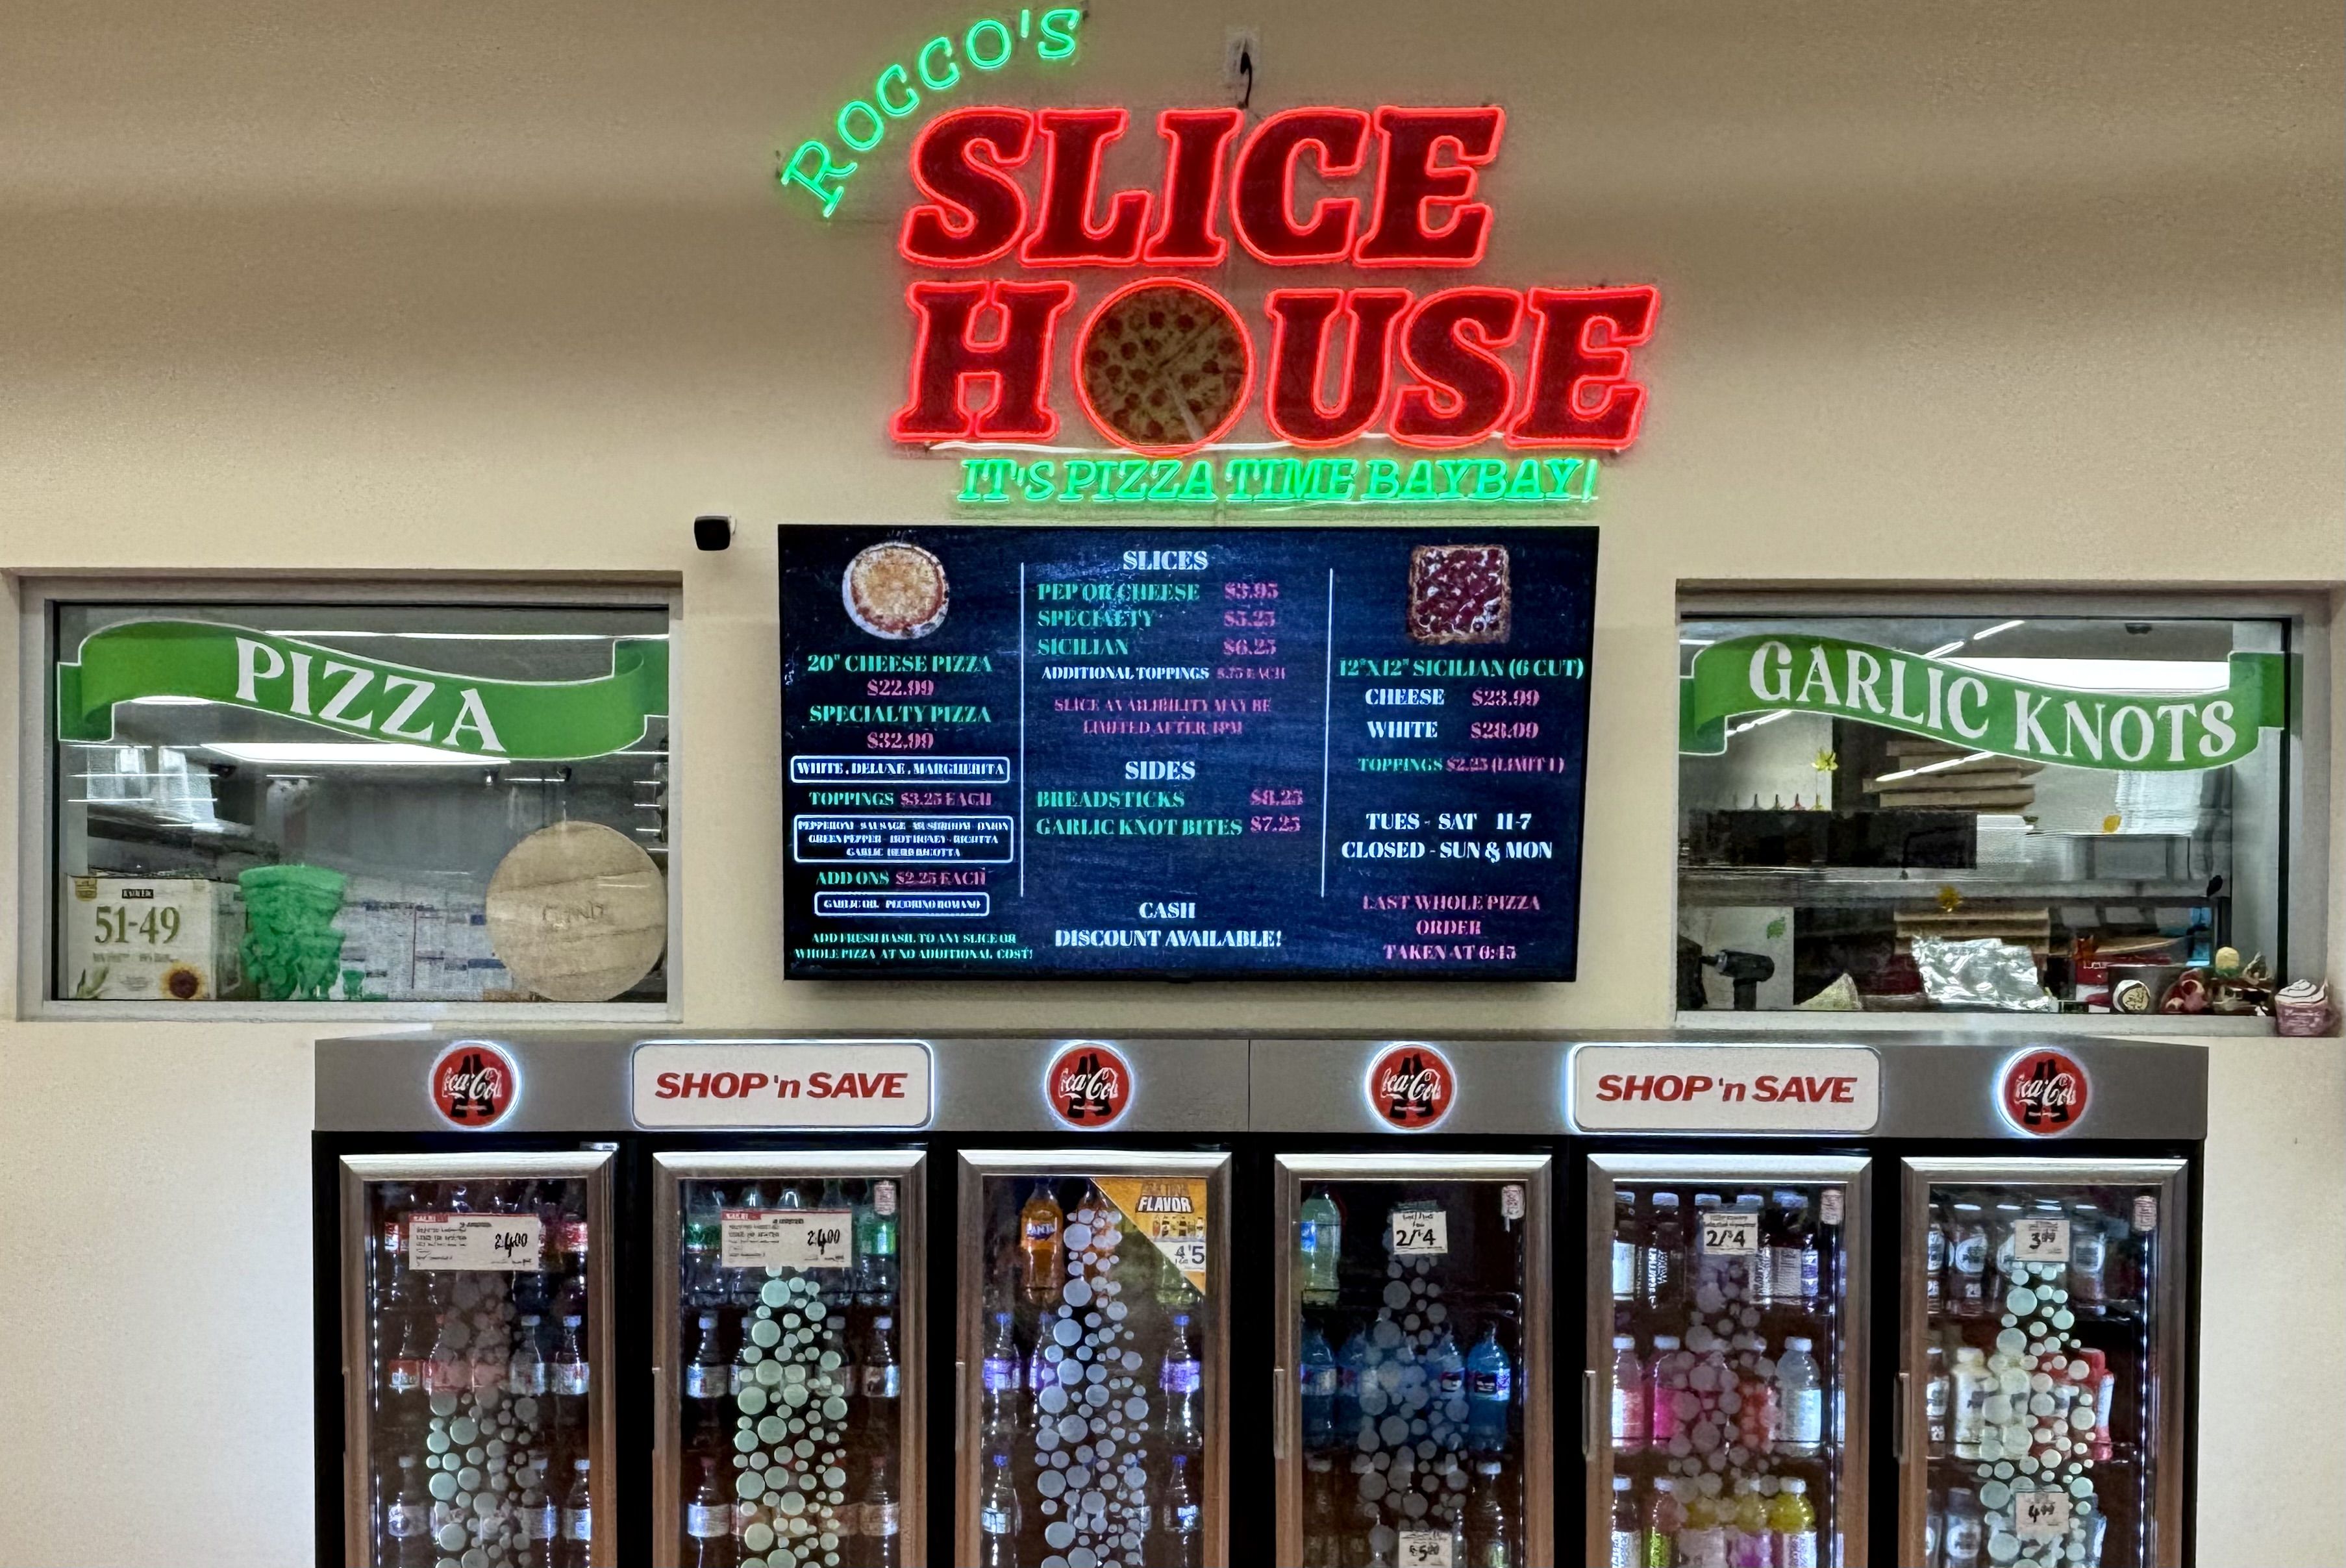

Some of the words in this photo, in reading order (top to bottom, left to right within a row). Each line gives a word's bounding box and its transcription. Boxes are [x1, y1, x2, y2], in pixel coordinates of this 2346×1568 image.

[780, 7, 1082, 218] ROCCO'S
[899, 105, 1506, 268] SLICE
[890, 277, 1661, 458] HOUSE
[957, 458, 1056, 503] IT'S
[1058, 458, 1216, 503] PIZZA
[1225, 458, 1356, 503] TIME
[1366, 458, 1599, 503] BAYBAY!
[1123, 551, 1209, 571] SLICES
[1038, 583, 1079, 601] PEP
[1082, 583, 1116, 601] OR
[1117, 583, 1200, 601] CHEESE
[1038, 610, 1154, 627] SPECIALTY
[1038, 638, 1129, 655] SICILIAN
[807, 654, 840, 672] 20"
[845, 654, 927, 672] CHEESE
[932, 655, 993, 673] PIZZA
[1413, 660, 1504, 677] SICILIAN
[1509, 658, 1529, 679] (6
[1534, 658, 1584, 679] CUT)
[1042, 667, 1134, 679] ADDITIONAL
[1137, 667, 1210, 679] TOPPINGS
[1246, 667, 1286, 680] EACH
[234, 637, 507, 753] PIZZA
[867, 679, 934, 696] $22.99
[1054, 699, 1099, 712] SLICE
[1214, 699, 1246, 712] MAY
[1253, 699, 1271, 712] BE
[1365, 688, 1445, 705] CHEESE
[1472, 690, 1540, 706] $23.99
[1749, 641, 1988, 740] GARLIC
[2014, 690, 2236, 762] KNOTS
[809, 705, 929, 723] SPECIALTY
[931, 706, 992, 723] PIZZA
[1083, 721, 1150, 734] LIMITED
[1154, 721, 1208, 734] AFTER
[1367, 721, 1438, 738] WHITE
[867, 732, 934, 749] $32.99
[913, 763, 1005, 775] MARGHERITA
[1125, 761, 1195, 780] SIDES
[1358, 758, 1442, 771] TOPPINGS
[808, 792, 894, 806] TOPPINGS
[946, 792, 992, 806] EACH
[1038, 791, 1185, 807] BREADSTICKS
[1036, 819, 1114, 835] GARLIC
[1119, 819, 1178, 835] KNOT
[1182, 819, 1243, 835] BITES
[1366, 813, 1419, 830] TUES
[1438, 813, 1477, 830] SAT
[1496, 813, 1532, 830] 11-7
[847, 848, 883, 856] GARLIC
[1341, 842, 1425, 858] CLOSED
[1440, 842, 1480, 858] SUN
[1485, 841, 1501, 863] &
[1505, 842, 1553, 858] MON
[816, 871, 852, 886] ADD
[856, 871, 890, 886] ONS
[940, 871, 986, 886] EACH
[1139, 902, 1195, 919] CASH
[1364, 895, 1410, 910] LAST
[1414, 895, 1483, 910] WHOLE
[1487, 895, 1541, 910] PIZZA
[95, 906, 181, 944] 51-49
[1416, 920, 1481, 935] ORDER
[813, 933, 838, 943] ADD
[840, 933, 879, 943] FRESH
[881, 933, 916, 943] BASIL
[917, 933, 935, 943] TO
[938, 933, 960, 943] ANY
[963, 933, 997, 943] SLICE
[999, 933, 1016, 943] OR
[1055, 930, 1160, 947] DISCOUNT
[1166, 930, 1282, 947] AVAILABLE!
[794, 949, 839, 959] WHOLE
[842, 949, 876, 959] PIZZA
[880, 949, 897, 959] AT
[899, 949, 916, 959] NO
[919, 949, 993, 959] ADDITIONAL
[1383, 945, 1446, 960] TAKEN
[1450, 945, 1475, 960] AT
[655, 1072, 766, 1099] SHOP
[773, 1075, 801, 1099] 'n
[806, 1072, 908, 1099] SAVE
[1596, 1075, 1712, 1102] SHOP
[1718, 1078, 1745, 1102] 'n
[1753, 1075, 1858, 1103] SAVE
[1138, 1196, 1192, 1212] FLAVOR
